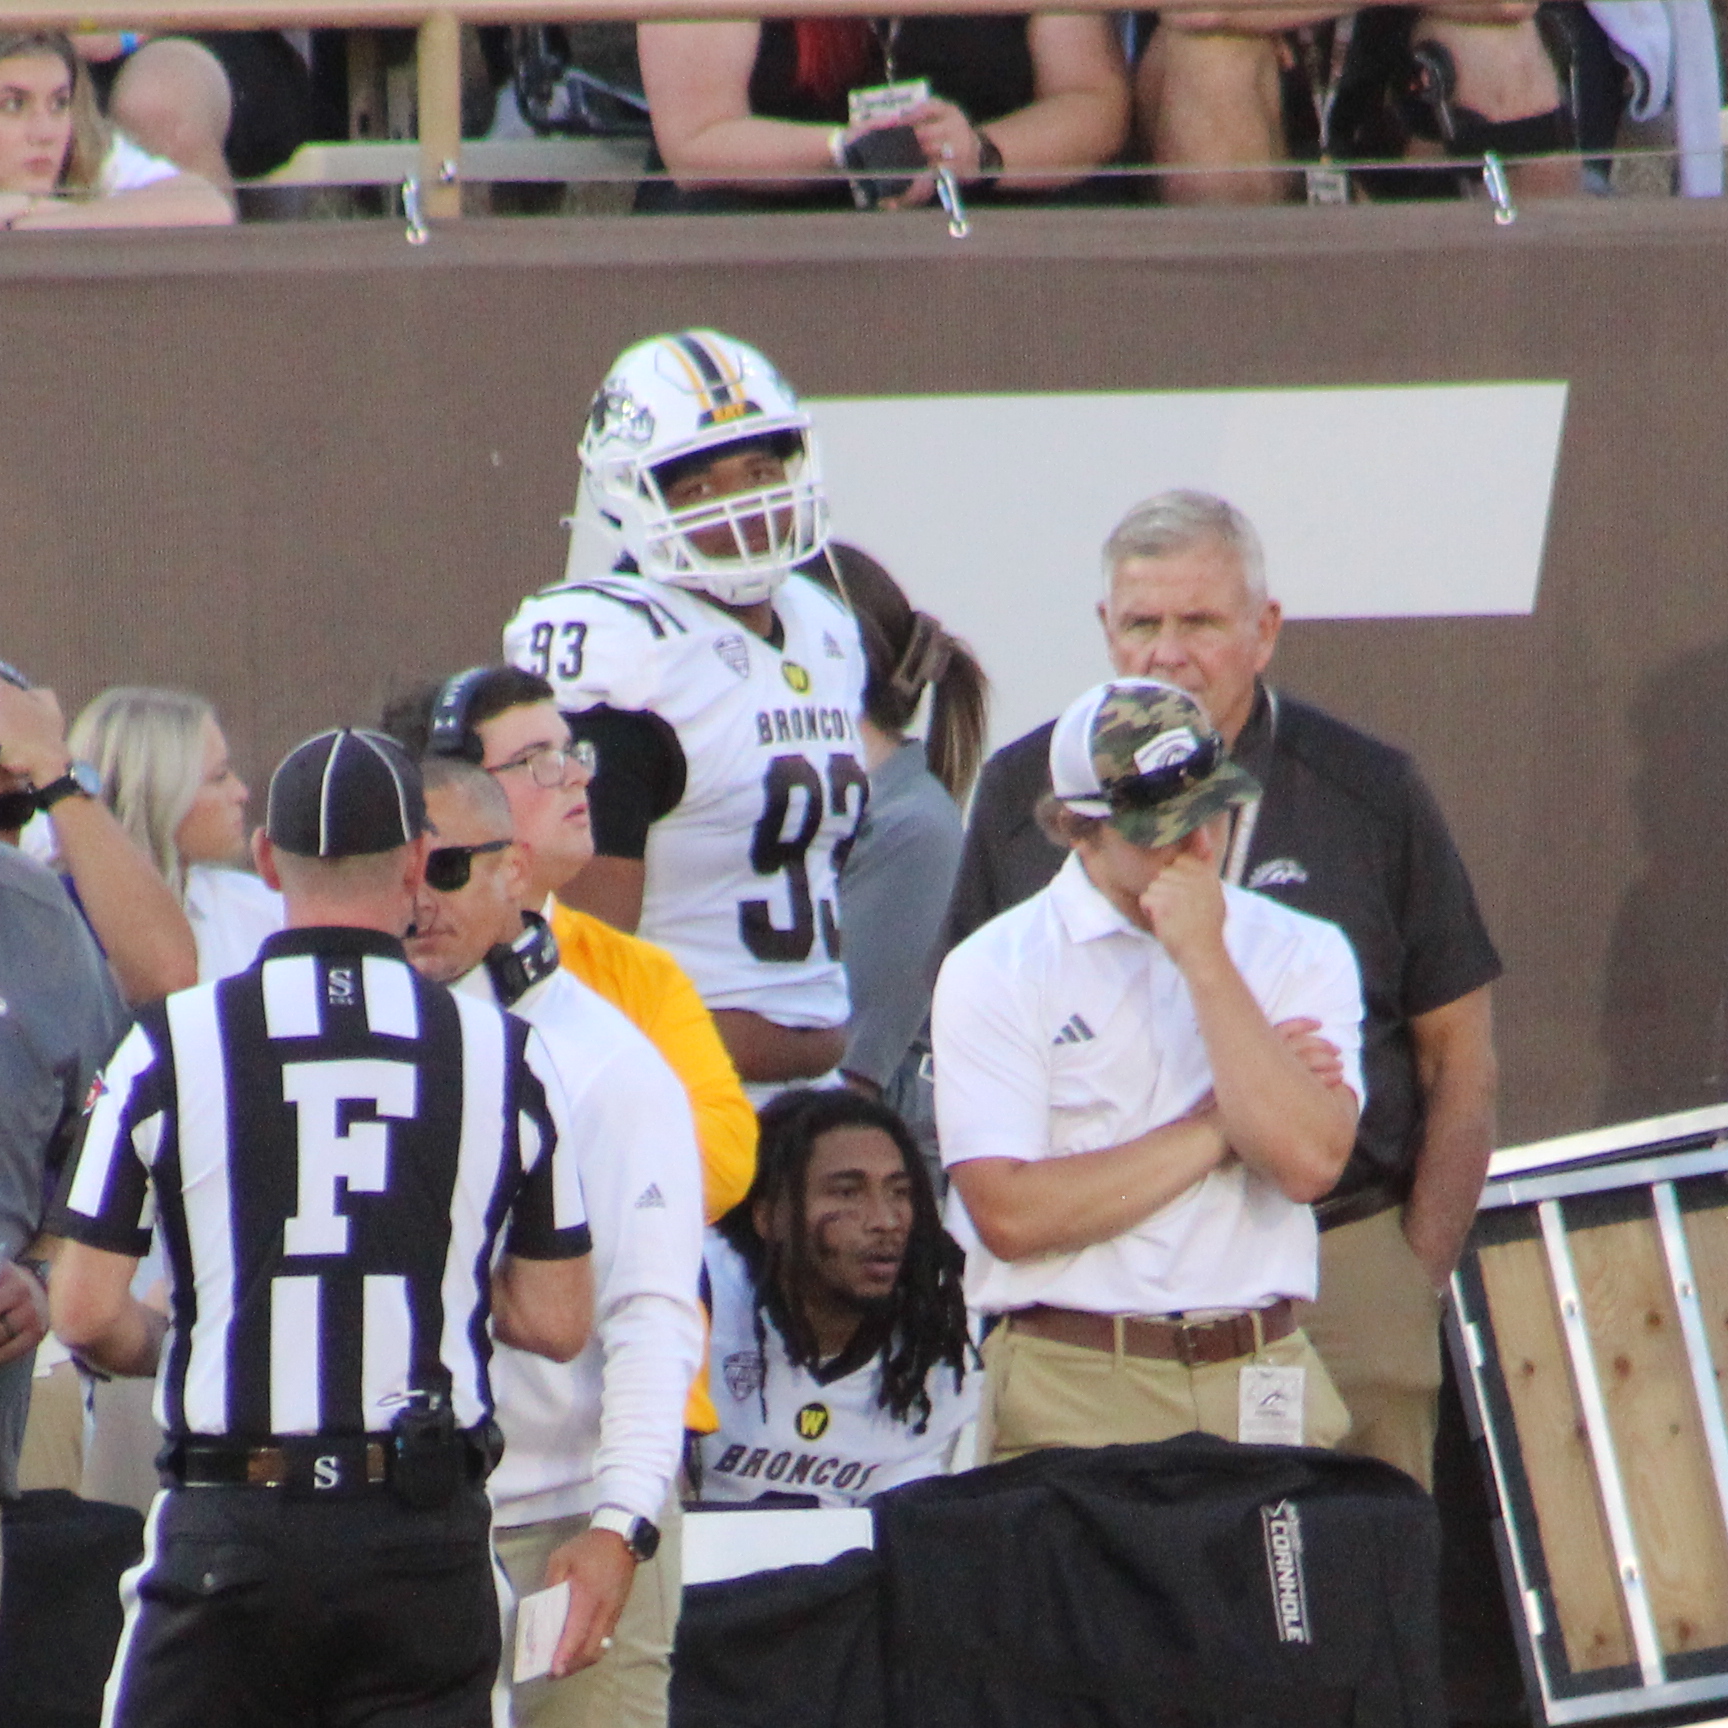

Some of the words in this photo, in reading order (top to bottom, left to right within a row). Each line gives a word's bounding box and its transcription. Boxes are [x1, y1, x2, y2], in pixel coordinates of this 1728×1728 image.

[529, 621, 587, 681] 93
[737, 752, 870, 963] 93
[282, 1058, 418, 1257] F
[800, 1409, 827, 1437] W
[314, 1455, 339, 1489] S
[1271, 1518, 1305, 1644] CORNHOLE
